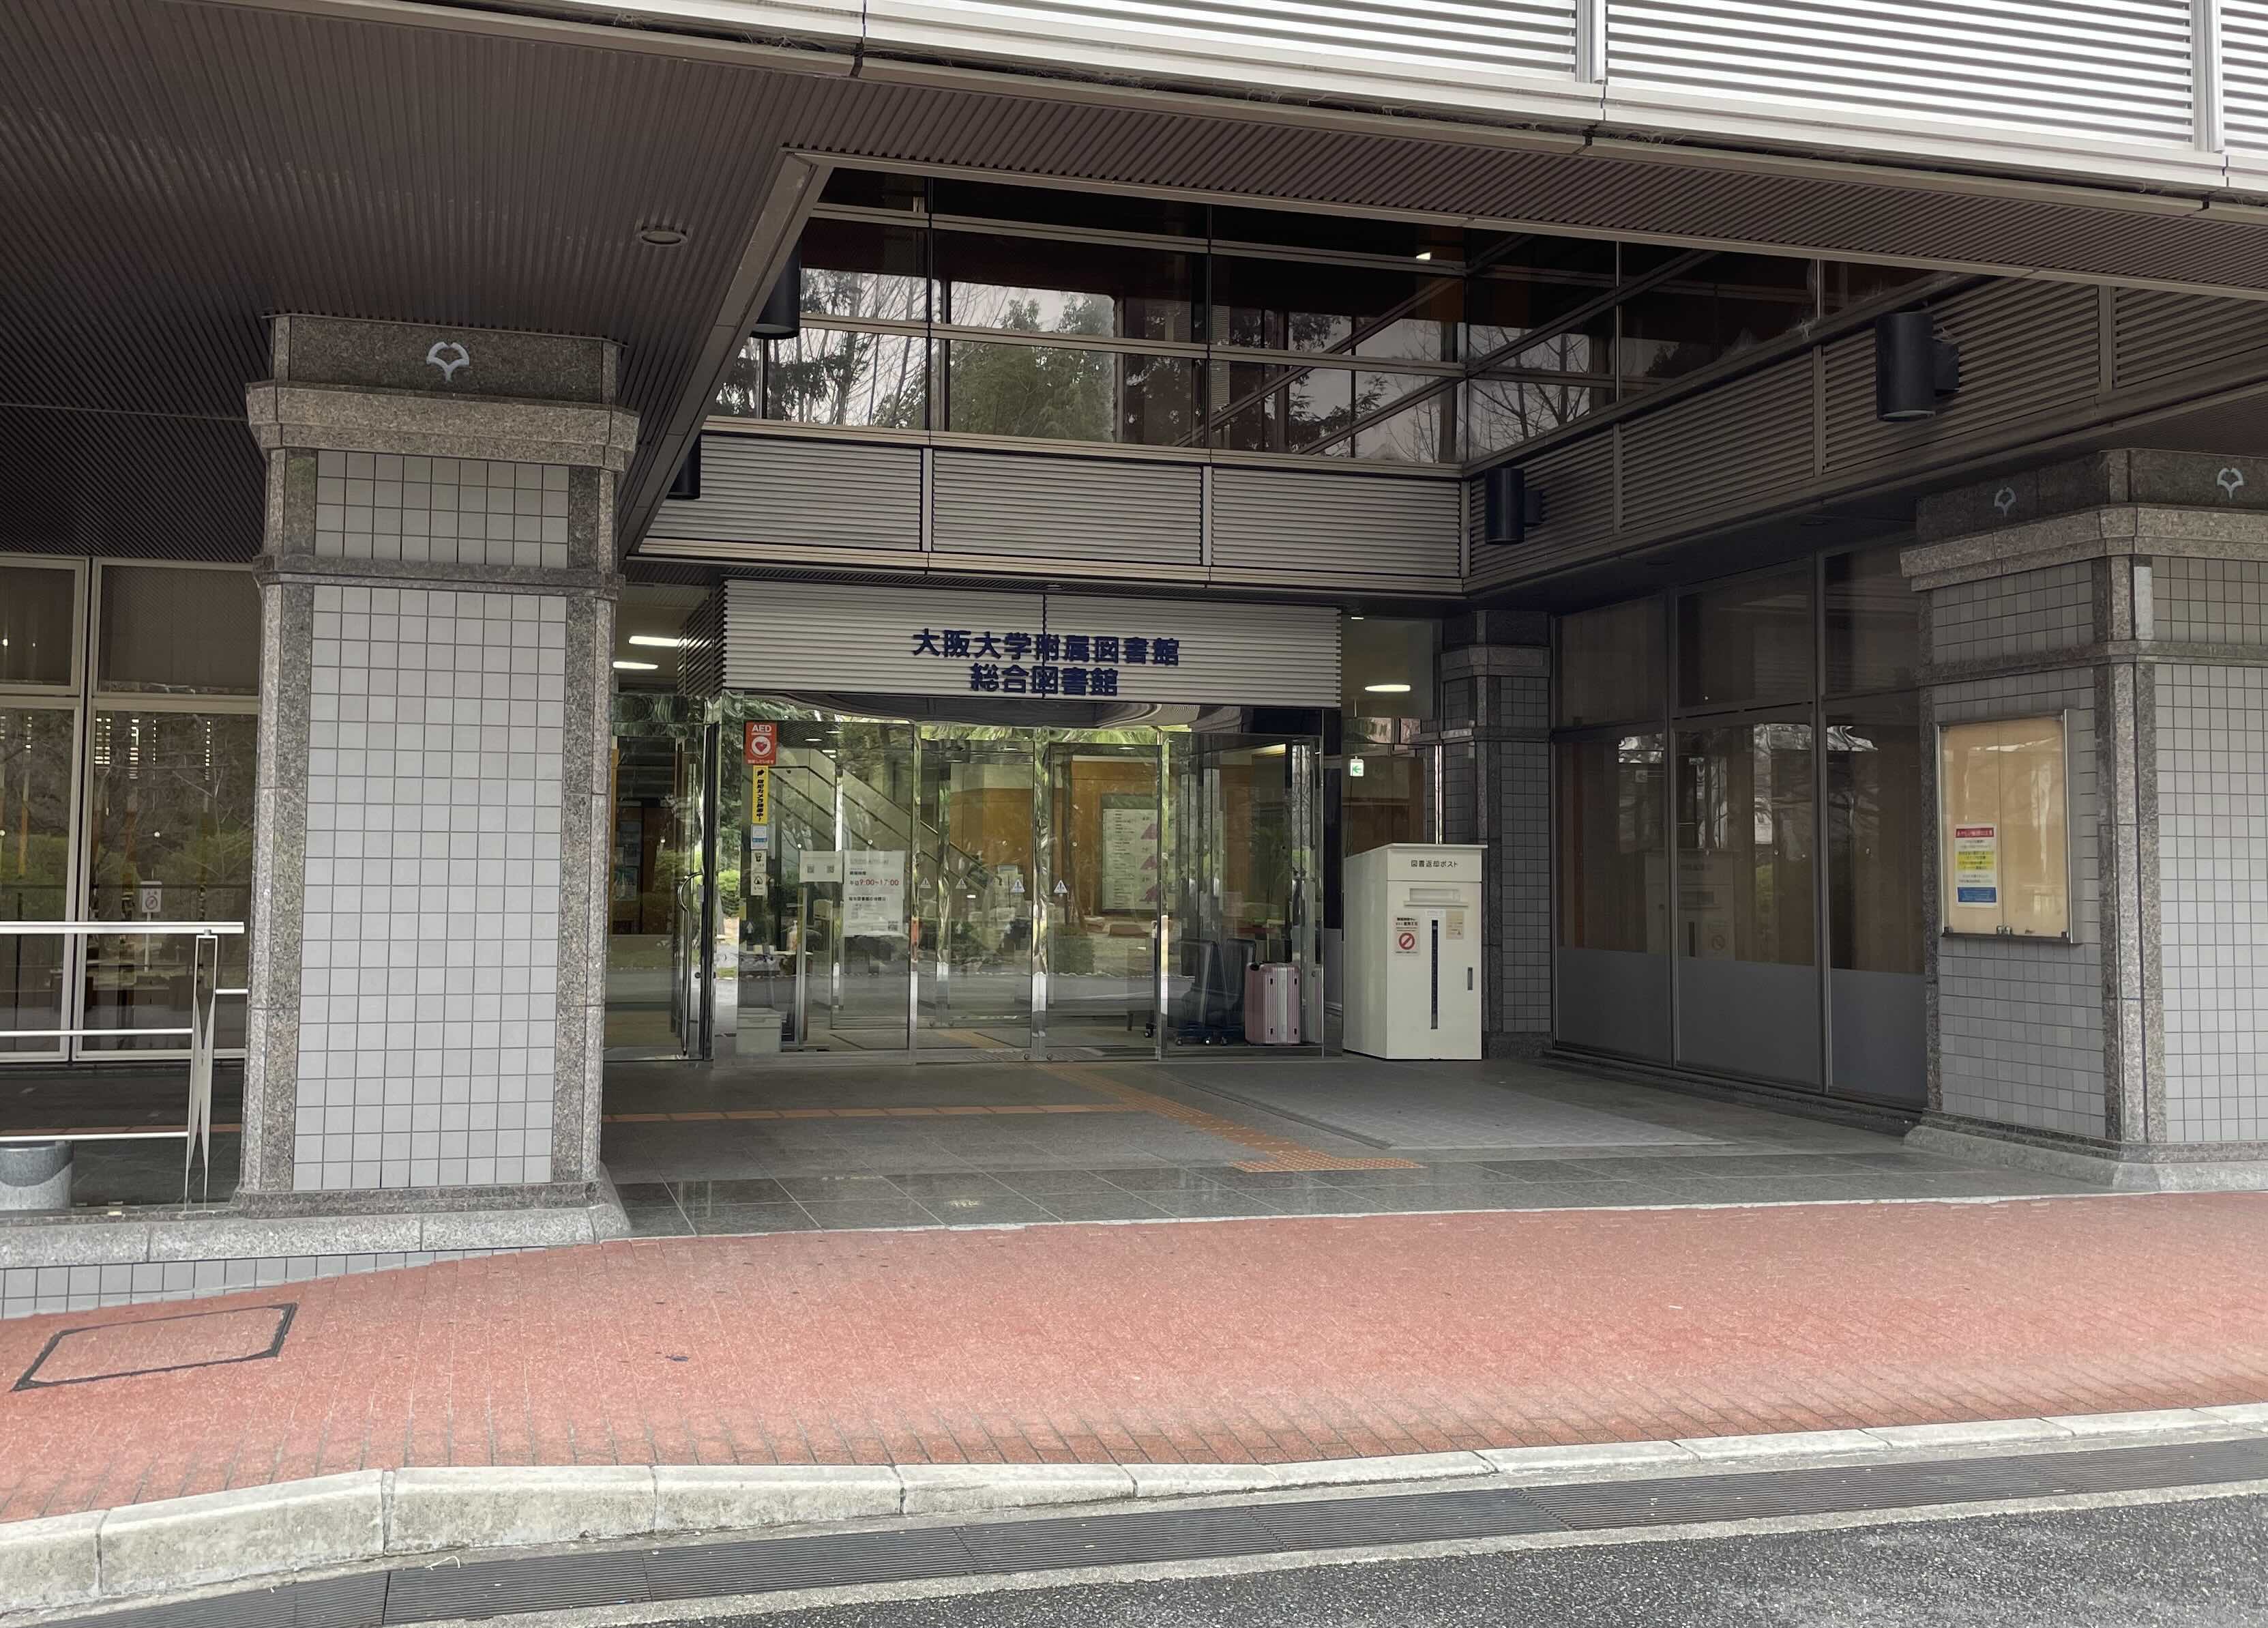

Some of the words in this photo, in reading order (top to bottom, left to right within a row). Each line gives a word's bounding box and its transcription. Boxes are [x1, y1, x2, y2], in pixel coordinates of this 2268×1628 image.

[913, 627, 1180, 666] 大阪大学附属図書館
[970, 663, 1119, 697] 総合図書館
[752, 724, 772, 732] AED
[1411, 859, 1458, 868] 図書返却ポスト
